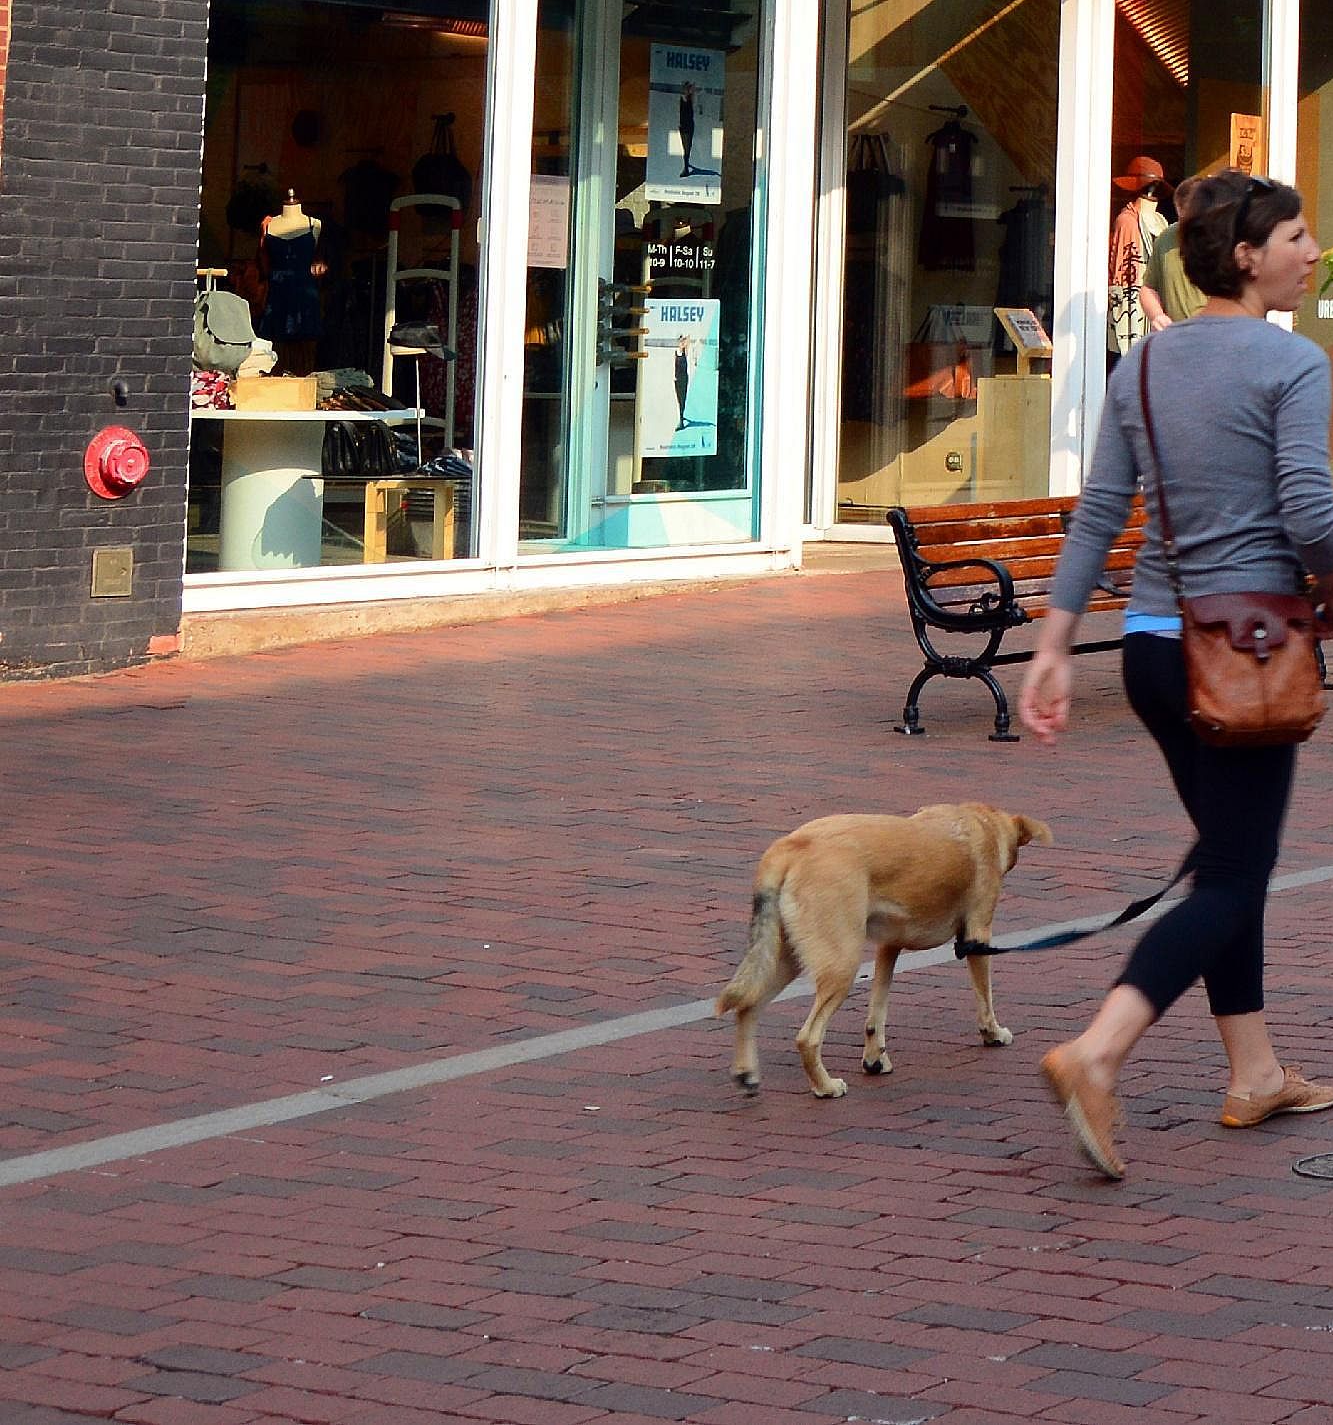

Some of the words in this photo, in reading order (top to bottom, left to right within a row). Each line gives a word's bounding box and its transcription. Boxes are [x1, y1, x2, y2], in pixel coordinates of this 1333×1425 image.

[666, 51, 711, 72] HALSEY
[647, 243, 668, 255] M-Th
[675, 245, 693, 256] F-Sa
[702, 246, 713, 257] Su
[673, 258, 694, 269] 10-10
[699, 259, 716, 270] 11-7
[660, 305, 705, 322] HALSEY
